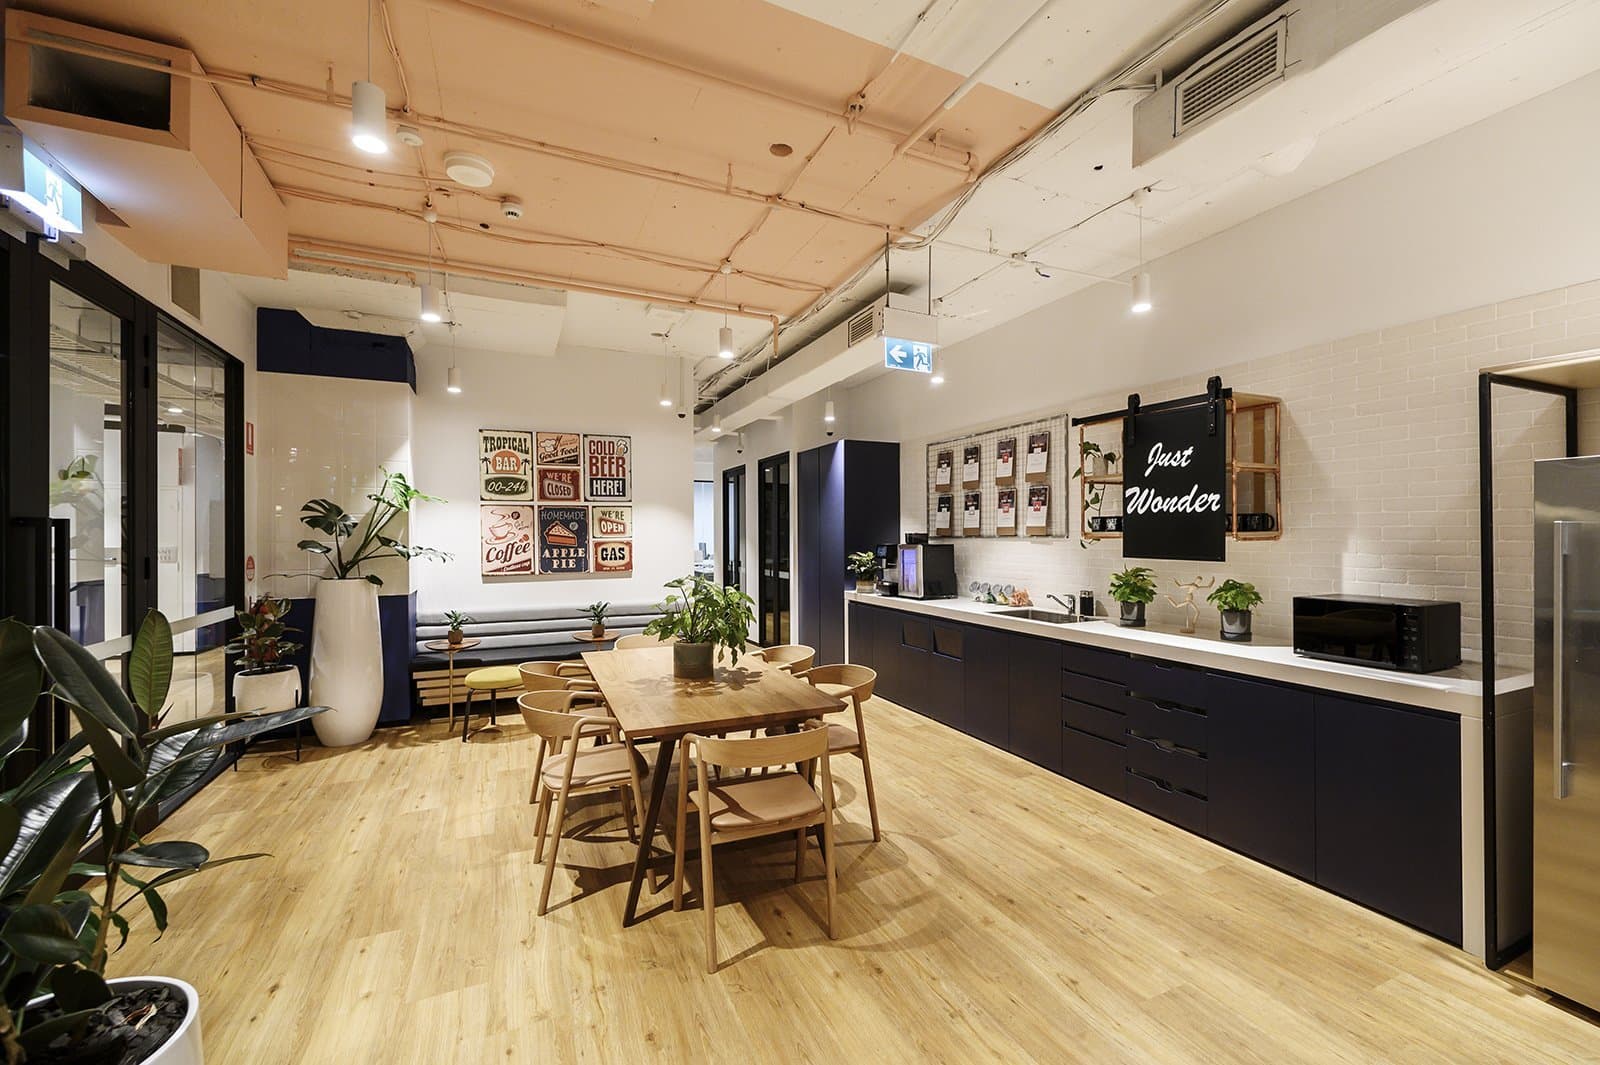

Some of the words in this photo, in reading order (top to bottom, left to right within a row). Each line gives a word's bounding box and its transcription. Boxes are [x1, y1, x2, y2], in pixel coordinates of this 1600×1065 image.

[483, 436, 530, 455] TROPICAL
[588, 440, 615, 456] COLD
[539, 450, 559, 460] Good
[1144, 442, 1194, 477] Just
[495, 456, 518, 471] BAR
[588, 455, 626, 478] BEER
[546, 472, 572, 484] WE'RE
[487, 480, 527, 493] 00-24h
[546, 482, 572, 497] CLOSED
[592, 480, 623, 496] HERE!
[1124, 484, 1221, 515] Wonder
[540, 510, 586, 521] HOMEMADE
[600, 510, 625, 521] WE'RE
[600, 520, 625, 534] OPEN
[485, 541, 531, 564] Coffee
[542, 548, 586, 558] APPLE
[600, 547, 626, 562] GAS
[552, 559, 577, 569] PIE
